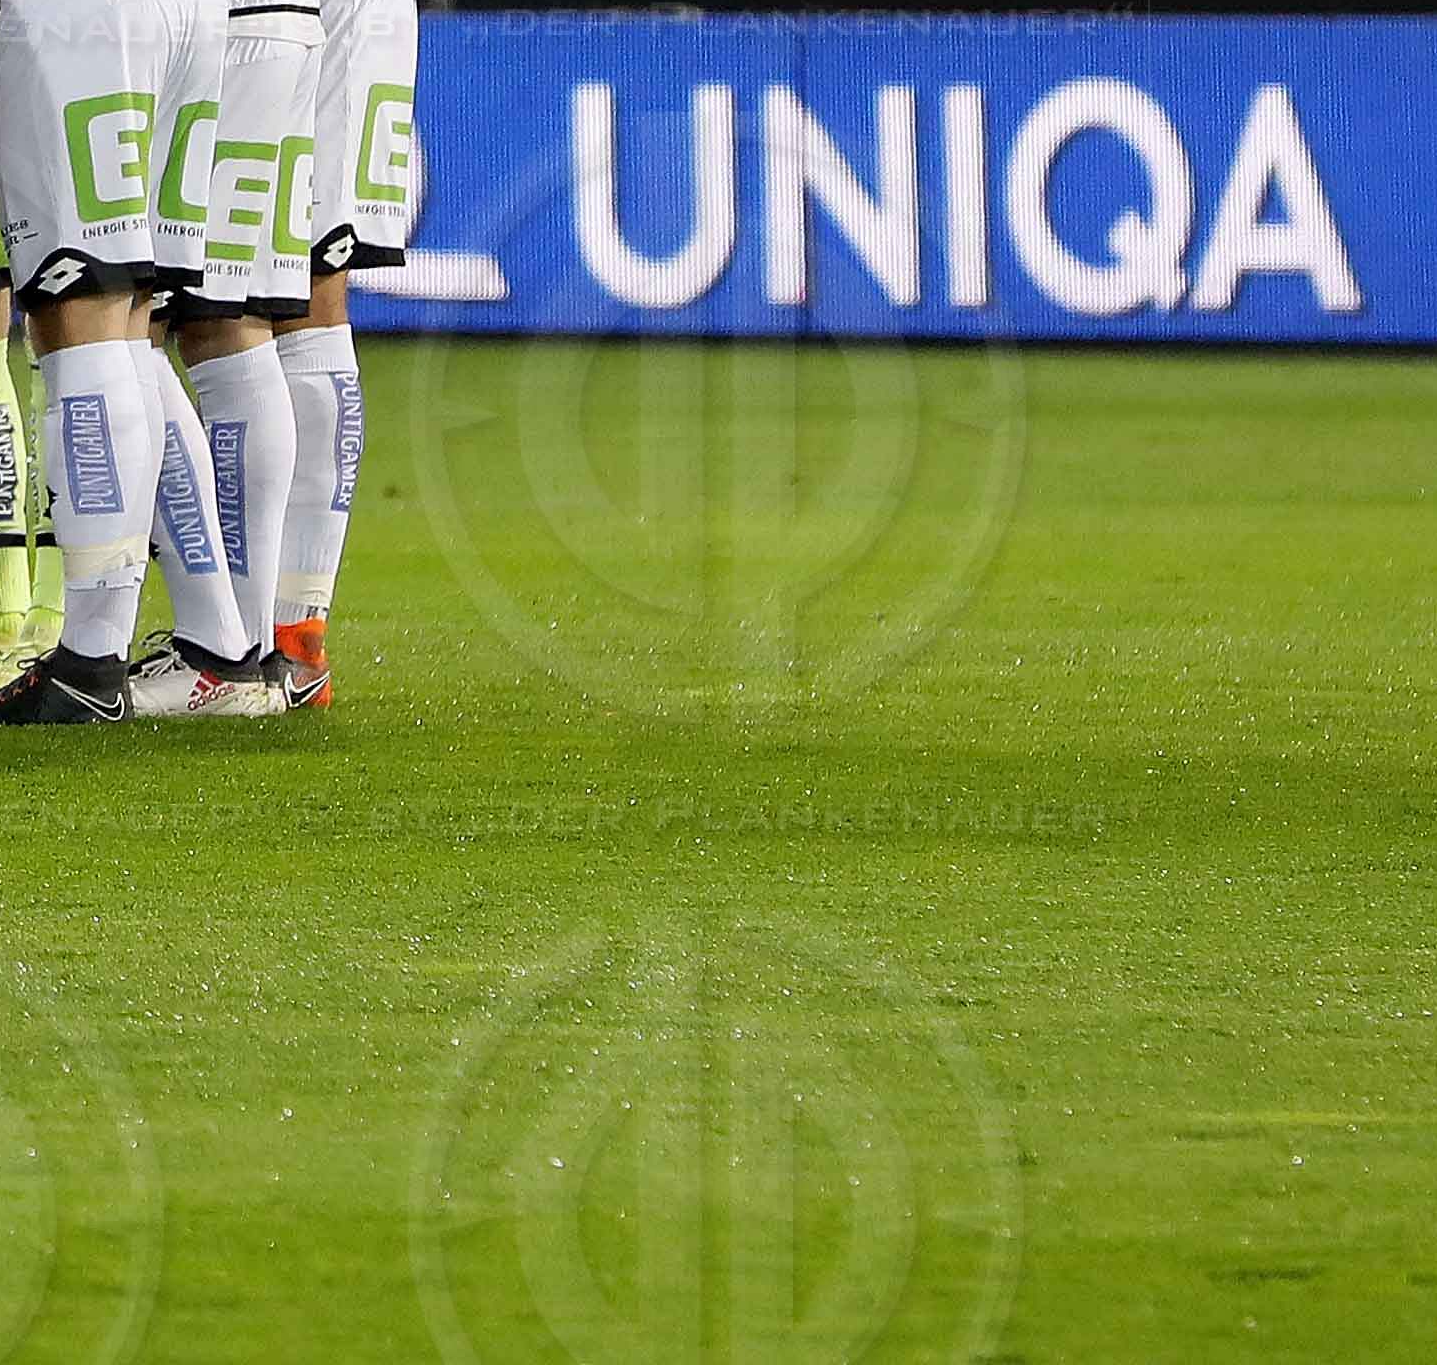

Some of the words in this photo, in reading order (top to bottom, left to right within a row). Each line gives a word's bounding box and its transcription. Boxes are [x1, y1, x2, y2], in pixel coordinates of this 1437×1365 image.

[572, 77, 1362, 315] UNIQA
[69, 397, 118, 511] PUNTIGAMER
[214, 427, 243, 566] PUNTIGAMER
[338, 370, 362, 506] PUNTIGAMER
